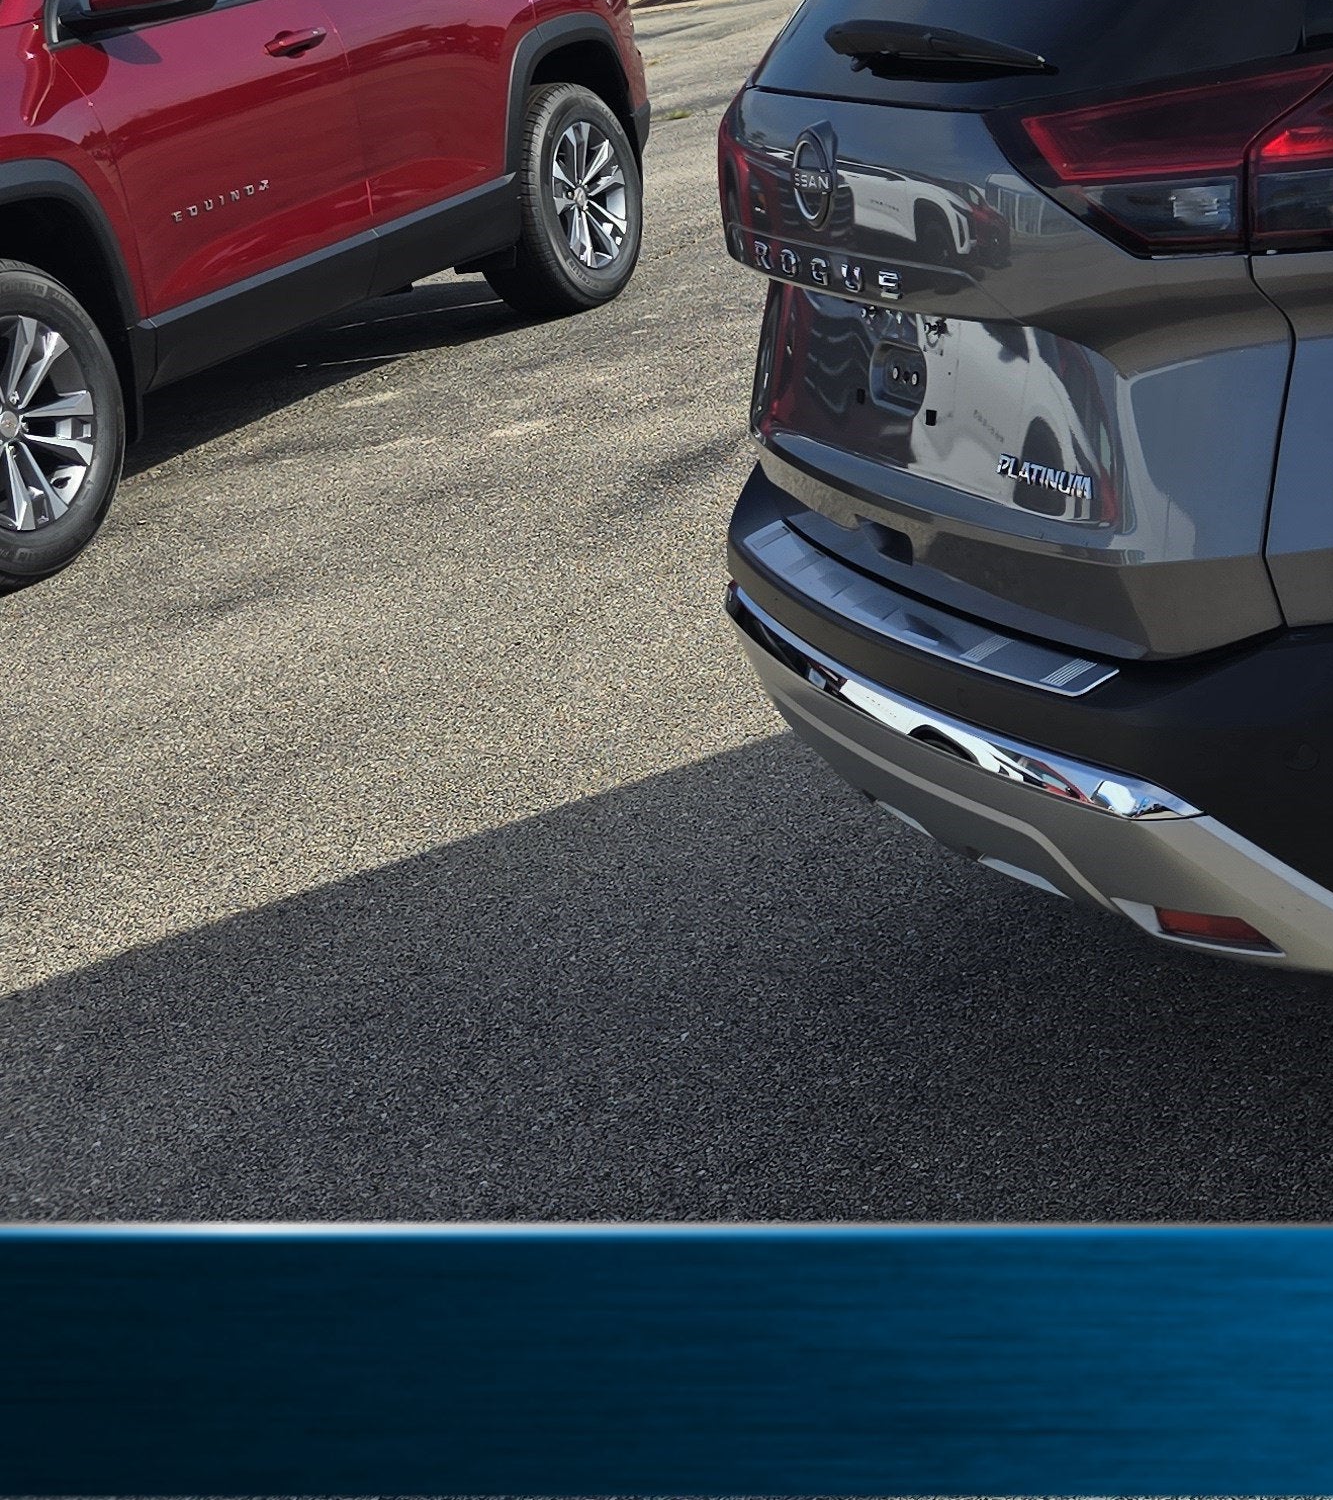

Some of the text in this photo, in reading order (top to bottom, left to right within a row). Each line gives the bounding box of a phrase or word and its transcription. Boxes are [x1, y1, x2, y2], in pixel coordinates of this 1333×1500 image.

[171, 179, 269, 222] EQUINOX
[753, 240, 901, 300] ROGUE
[996, 453, 1093, 500] PLATINUM
